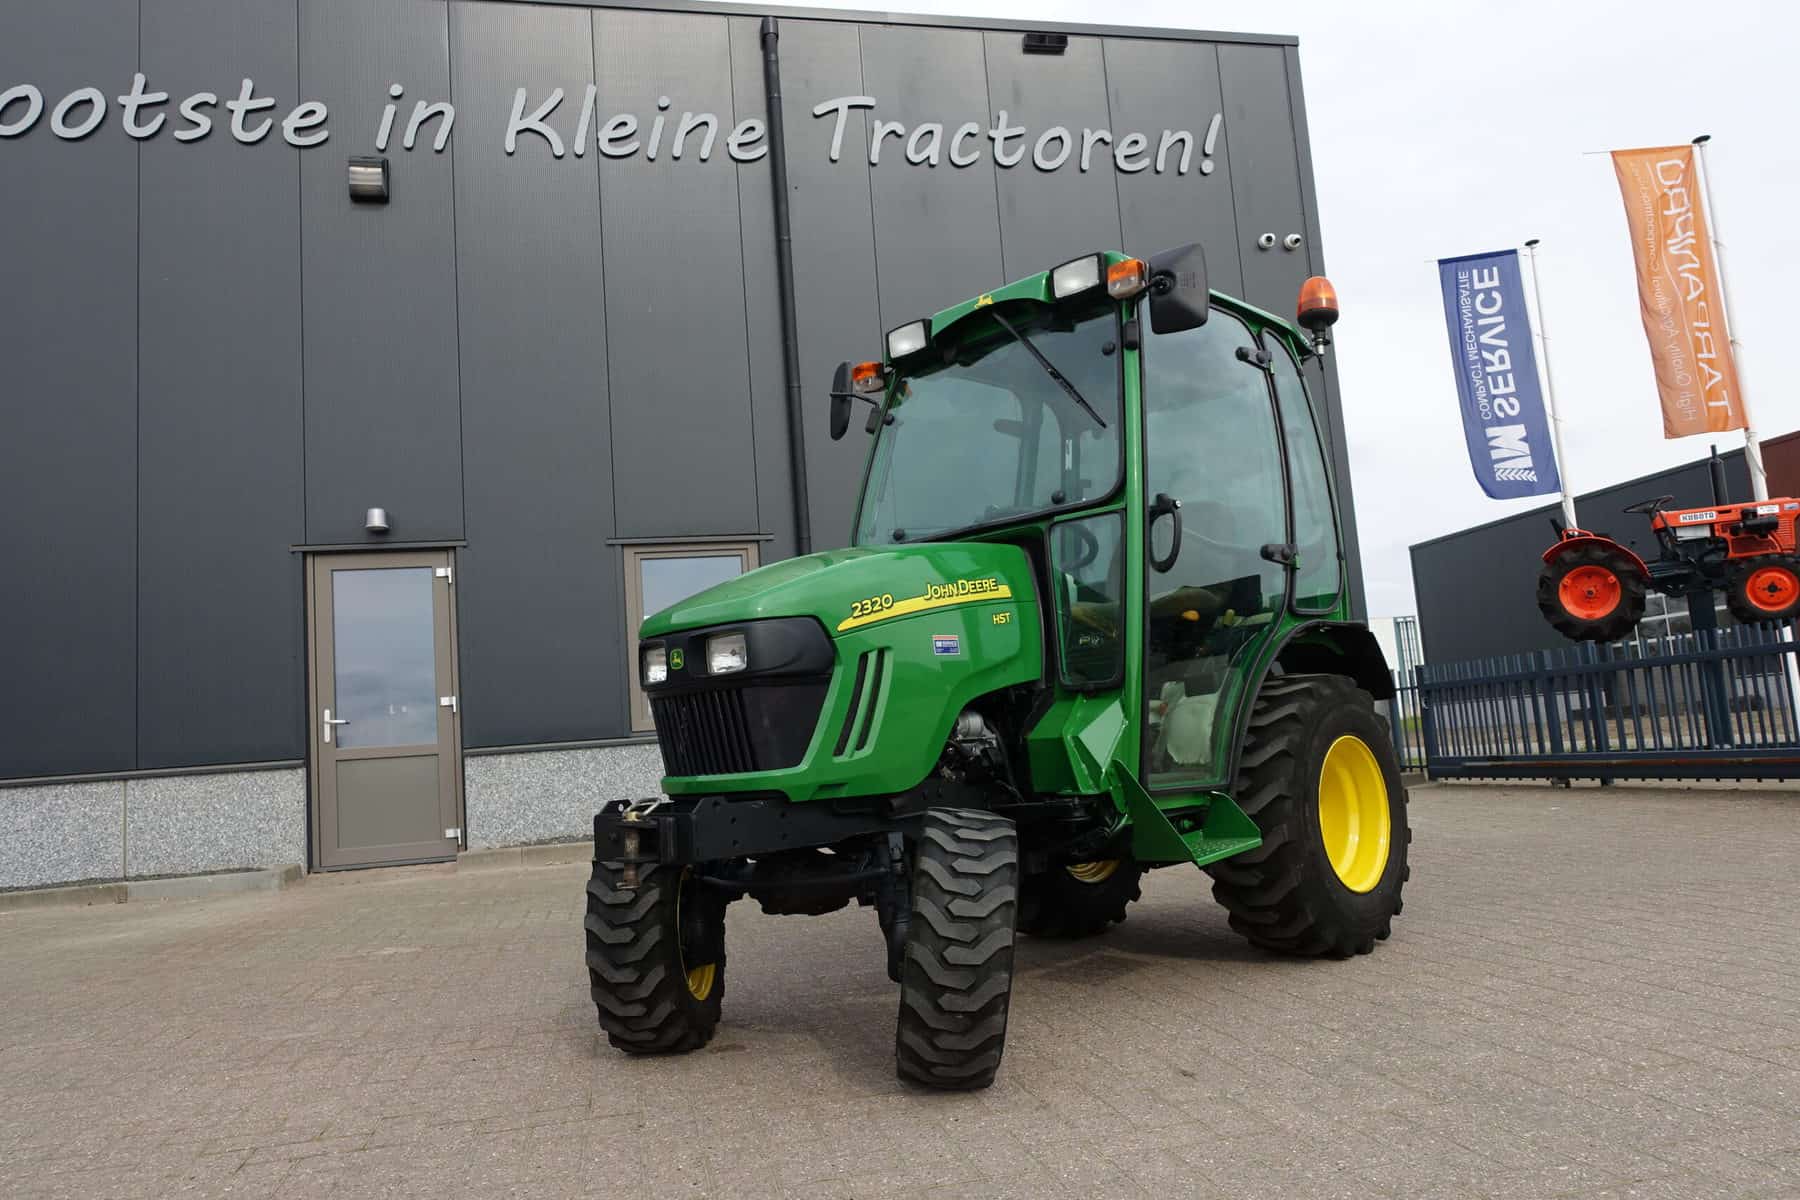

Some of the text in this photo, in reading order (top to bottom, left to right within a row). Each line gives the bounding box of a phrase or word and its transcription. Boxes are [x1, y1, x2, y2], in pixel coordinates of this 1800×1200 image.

[0, 72, 1222, 175] ootste in Kleine Tractoren!
[852, 594, 894, 618] 2320
[992, 612, 1011, 625] HST
